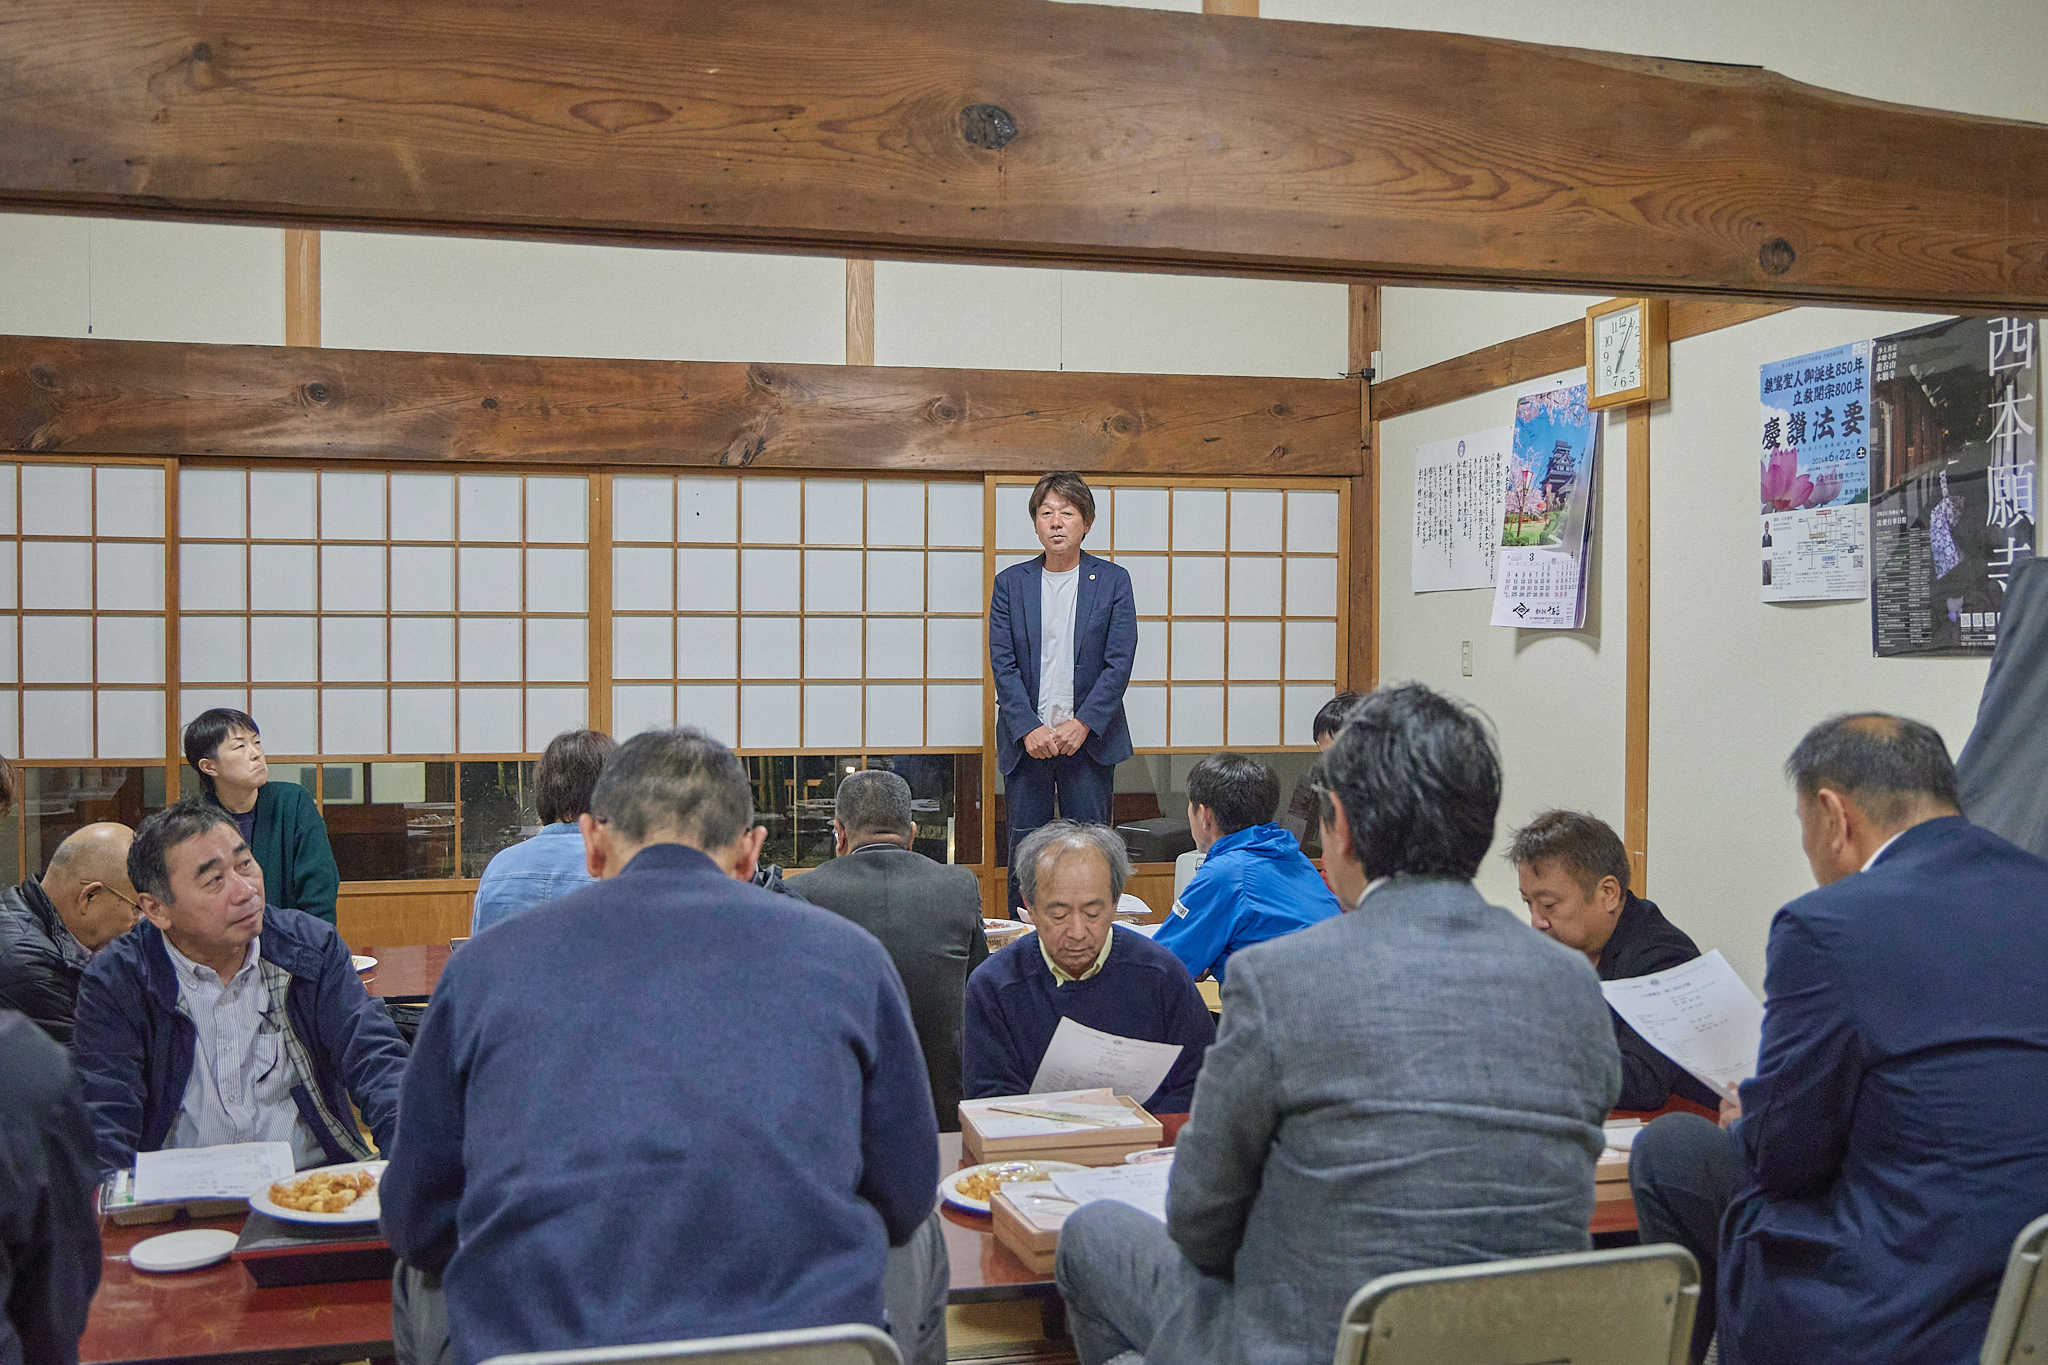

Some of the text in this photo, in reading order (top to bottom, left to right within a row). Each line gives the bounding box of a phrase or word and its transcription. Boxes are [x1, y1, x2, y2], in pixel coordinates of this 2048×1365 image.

[1611, 321, 1618, 334] 11
[1619, 316, 1627, 328] 12
[1634, 326, 1640, 338] 2
[1604, 335, 1613, 347] 10
[1603, 351, 1609, 363] 9
[1606, 366, 1612, 377] 8
[1629, 371, 1635, 383] 5
[1764, 357, 1865, 394] 親鸞聖人御誕生850年
[1613, 375, 1619, 387] 7
[1620, 376, 1627, 388] 6
[1792, 377, 1864, 406] 立教開宗800年
[1857, 447, 1867, 459] 土
[1529, 552, 1535, 562] 3
